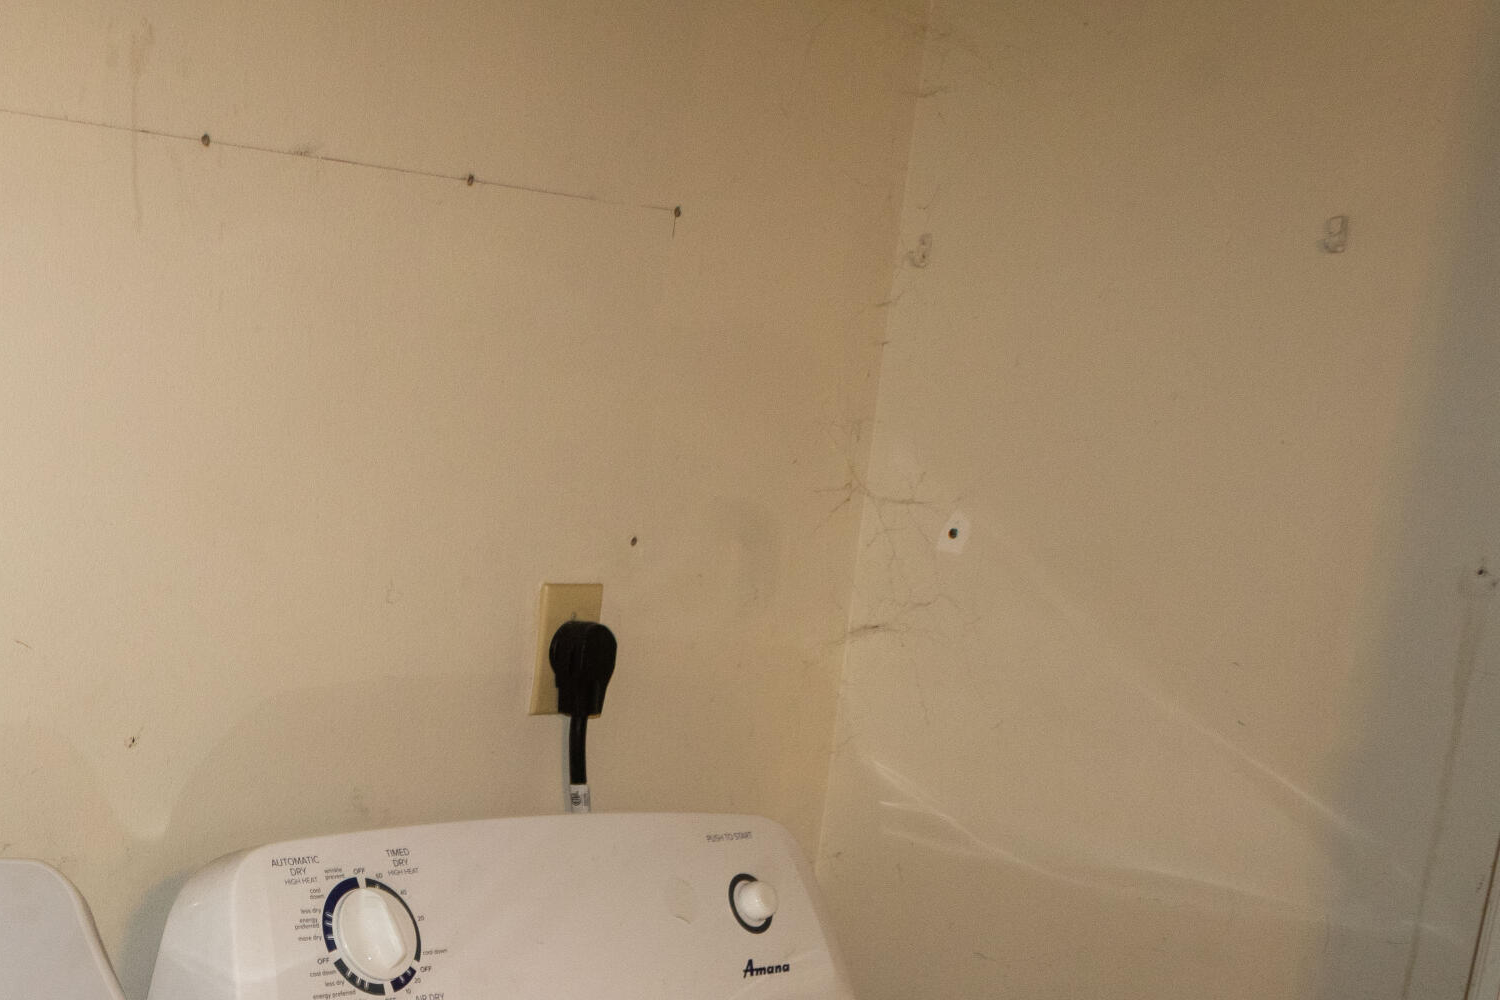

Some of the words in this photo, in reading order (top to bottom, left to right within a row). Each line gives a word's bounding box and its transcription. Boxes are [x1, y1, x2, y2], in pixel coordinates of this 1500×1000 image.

[386, 848, 410, 857] TIMED
[271, 855, 320, 867] AUTOMATIC
[392, 859, 408, 867] DRY
[290, 867, 307, 877] DRY
[353, 867, 365, 876] OFF
[404, 867, 419, 875] HEAT
[302, 876, 318, 885] HEAT
[317, 957, 330, 966] OFF
[743, 958, 790, 979] Amana
